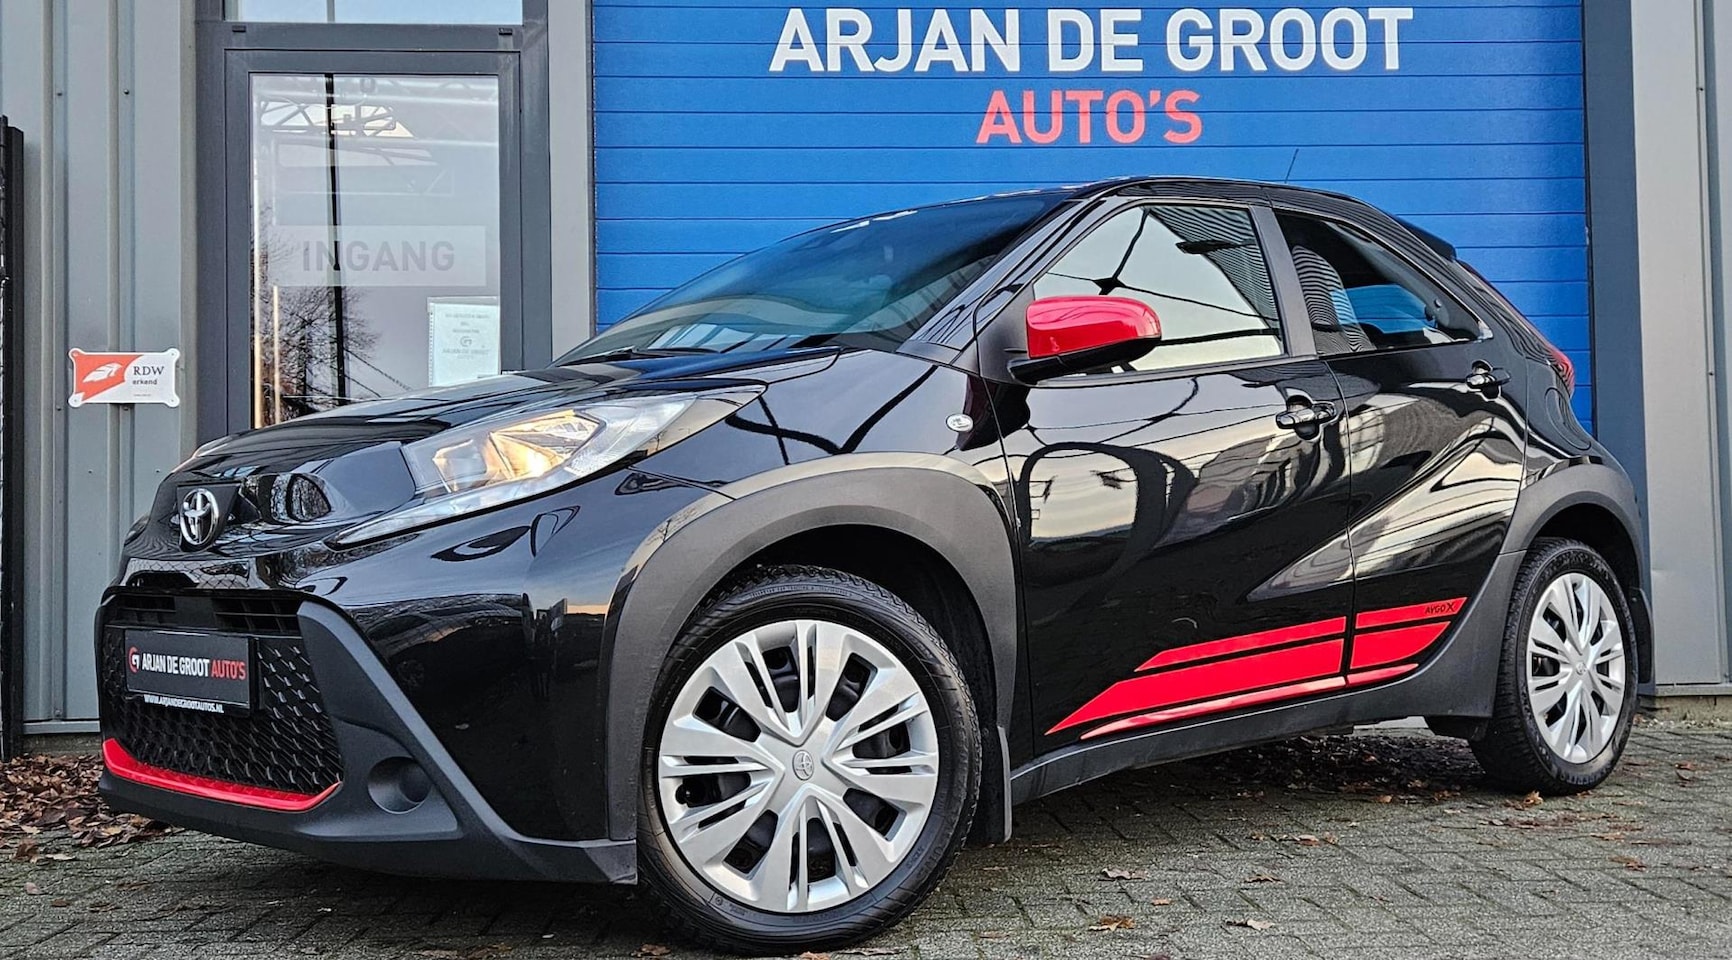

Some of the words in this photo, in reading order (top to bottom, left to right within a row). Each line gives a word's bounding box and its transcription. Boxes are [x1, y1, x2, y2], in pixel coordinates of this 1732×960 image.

[769, 8, 1020, 72] ARJAN
[1048, 8, 1143, 72] DE
[1166, 8, 1413, 72] GROOT
[976, 89, 1202, 144] AUTO'S
[303, 241, 455, 272] INGANG
[133, 366, 164, 376] RDW
[1425, 604, 1446, 614] AYGO
[142, 653, 166, 673] ARJAN
[166, 656, 179, 675] DE
[179, 658, 209, 677] GROOT
[211, 660, 246, 680] AUTO'S
